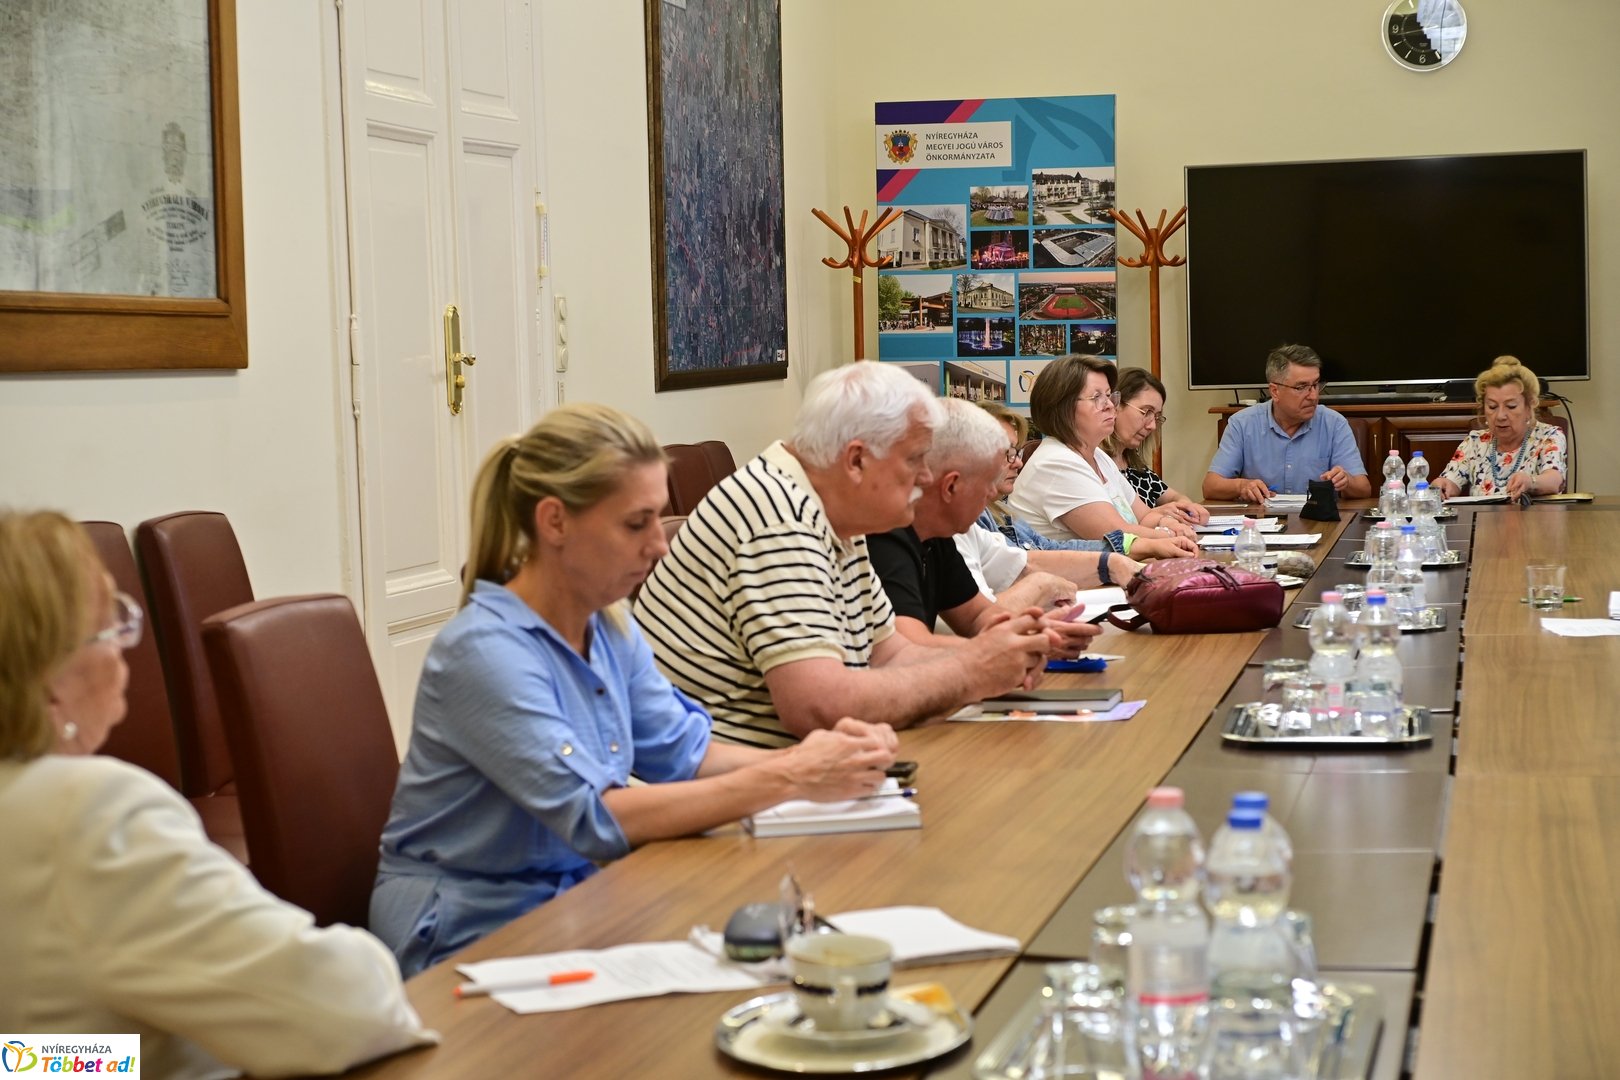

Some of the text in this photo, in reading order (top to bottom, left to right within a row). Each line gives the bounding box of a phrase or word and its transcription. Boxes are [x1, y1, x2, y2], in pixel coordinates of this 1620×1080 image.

[1392, 24, 1399, 34] 9
[1419, 54, 1426, 63] 6
[925, 131, 979, 140] NYÍREGYHÁZA
[925, 140, 1004, 151] MEGYEI JOGÚ VÁROS
[925, 152, 996, 161] ÖNKORMÁNYZATA
